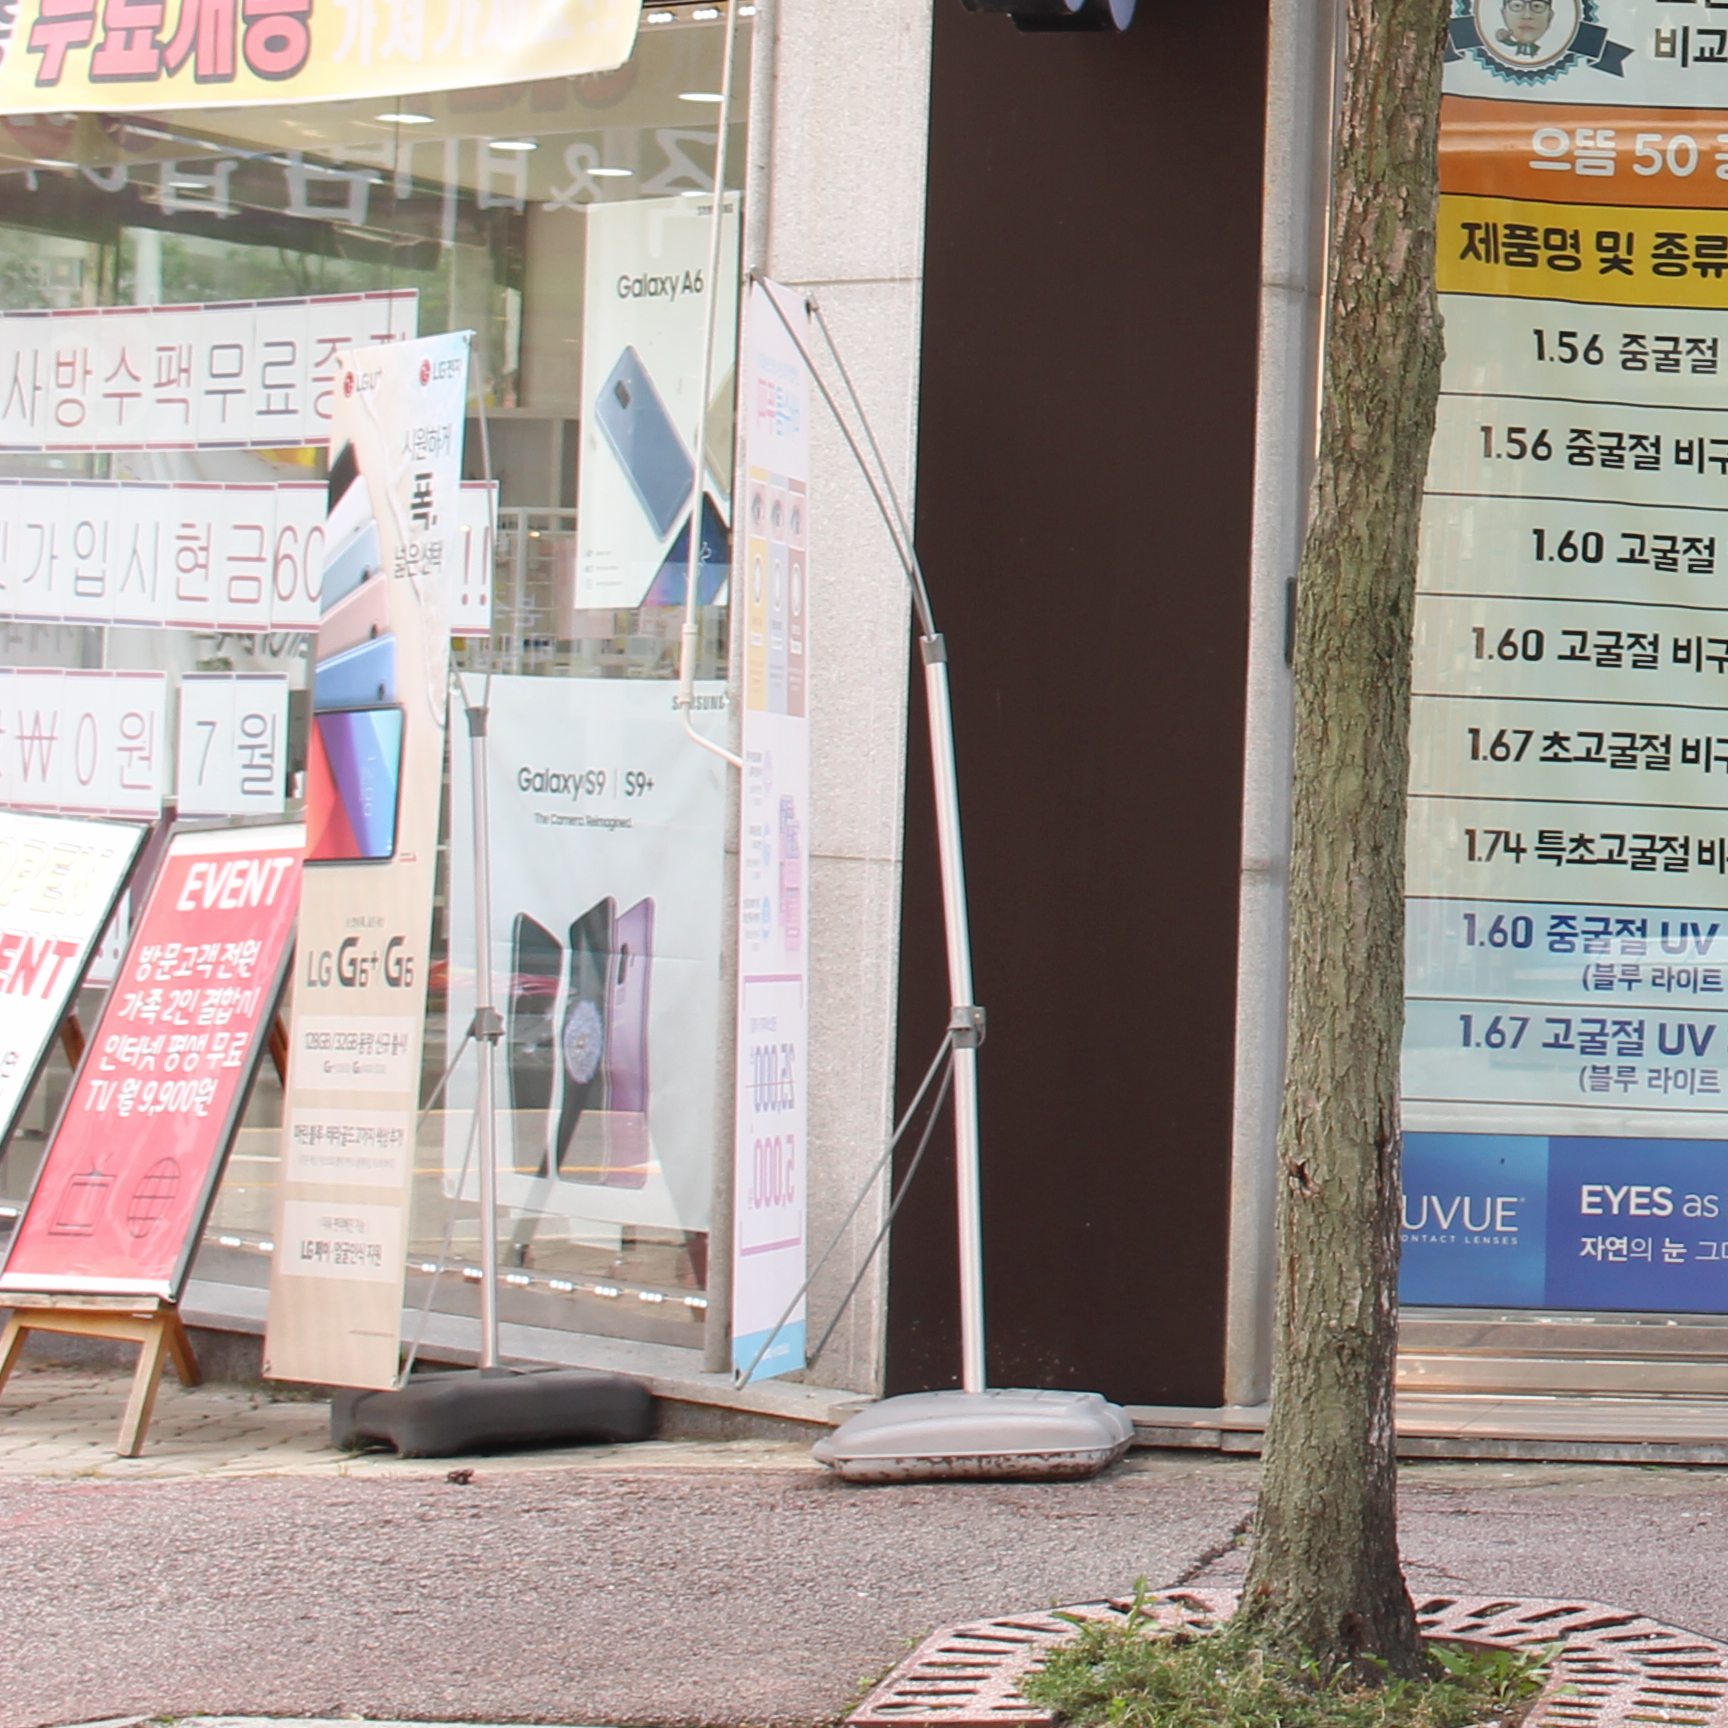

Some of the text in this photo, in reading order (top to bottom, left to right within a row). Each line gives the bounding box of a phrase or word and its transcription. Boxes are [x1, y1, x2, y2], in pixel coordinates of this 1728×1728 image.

[1528, 128, 1617, 178] 으뜸
[1632, 133, 1699, 178] 50
[1459, 220, 1582, 273] 제품명
[1594, 231, 1635, 276] 및
[617, 269, 705, 302] Galaxy A6
[1532, 328, 1605, 367] 1.56
[1618, 332, 1720, 375] 중굴절
[518, 766, 655, 798] Galaxy S9 S9+
[177, 855, 294, 911] EVENT
[1462, 912, 1534, 949] 1.60
[1546, 914, 1648, 956] 중굴절
[1660, 921, 1720, 956] UV
[136, 939, 262, 982] 방문고객 전원
[1582, 963, 1643, 994] (블루
[1650, 965, 1724, 995] 라이트
[118, 987, 164, 1026] 가족
[161, 987, 201, 1026] 2인
[99, 1030, 250, 1072] 인터넷 평생 무료
[84, 1076, 219, 1117] TV 월 9,900원
[1401, 1194, 1519, 1233] UVUE
